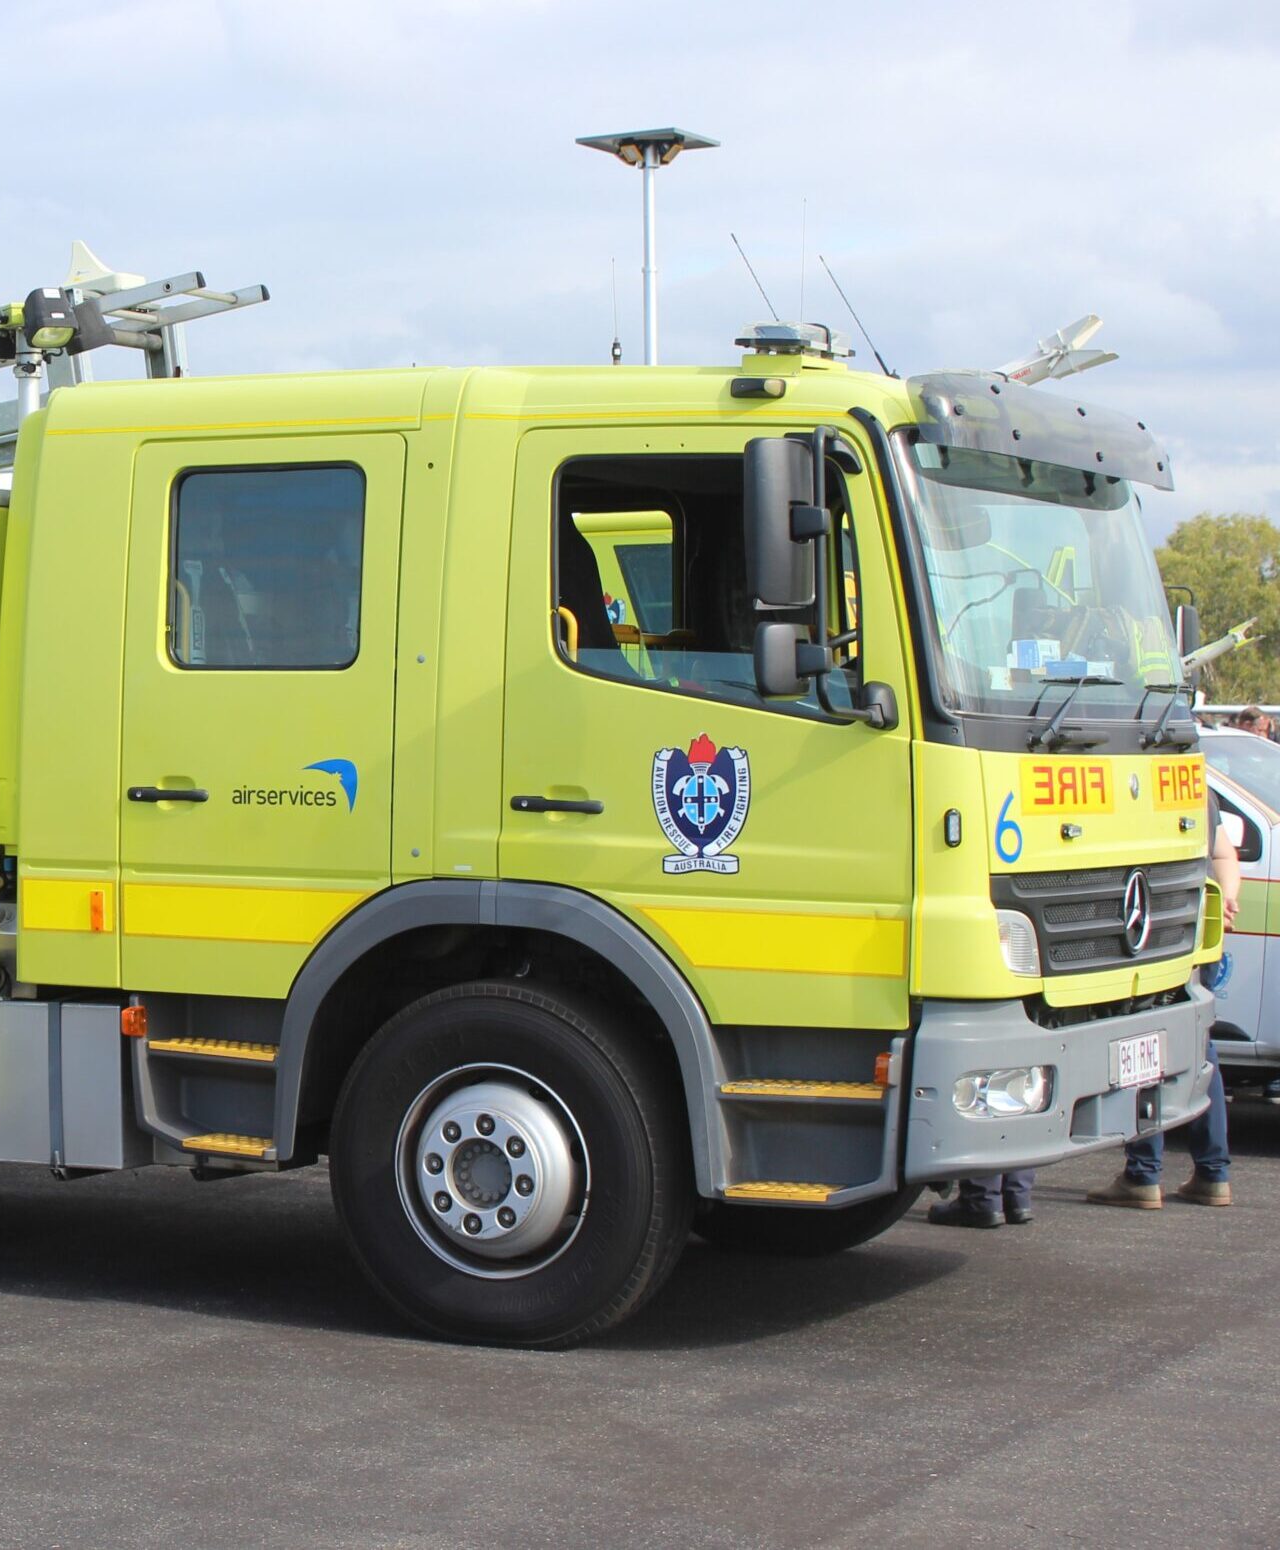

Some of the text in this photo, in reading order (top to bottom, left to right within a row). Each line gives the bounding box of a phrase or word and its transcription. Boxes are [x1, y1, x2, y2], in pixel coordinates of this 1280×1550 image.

[232, 785, 337, 807] airservices
[655, 766, 691, 852] AVIATION RESCUE
[716, 767, 748, 849] FIRE FIGHTING
[1158, 764, 1203, 802] FIRE
[995, 790, 1023, 864] 6
[674, 859, 727, 872] AUSTRALIA
